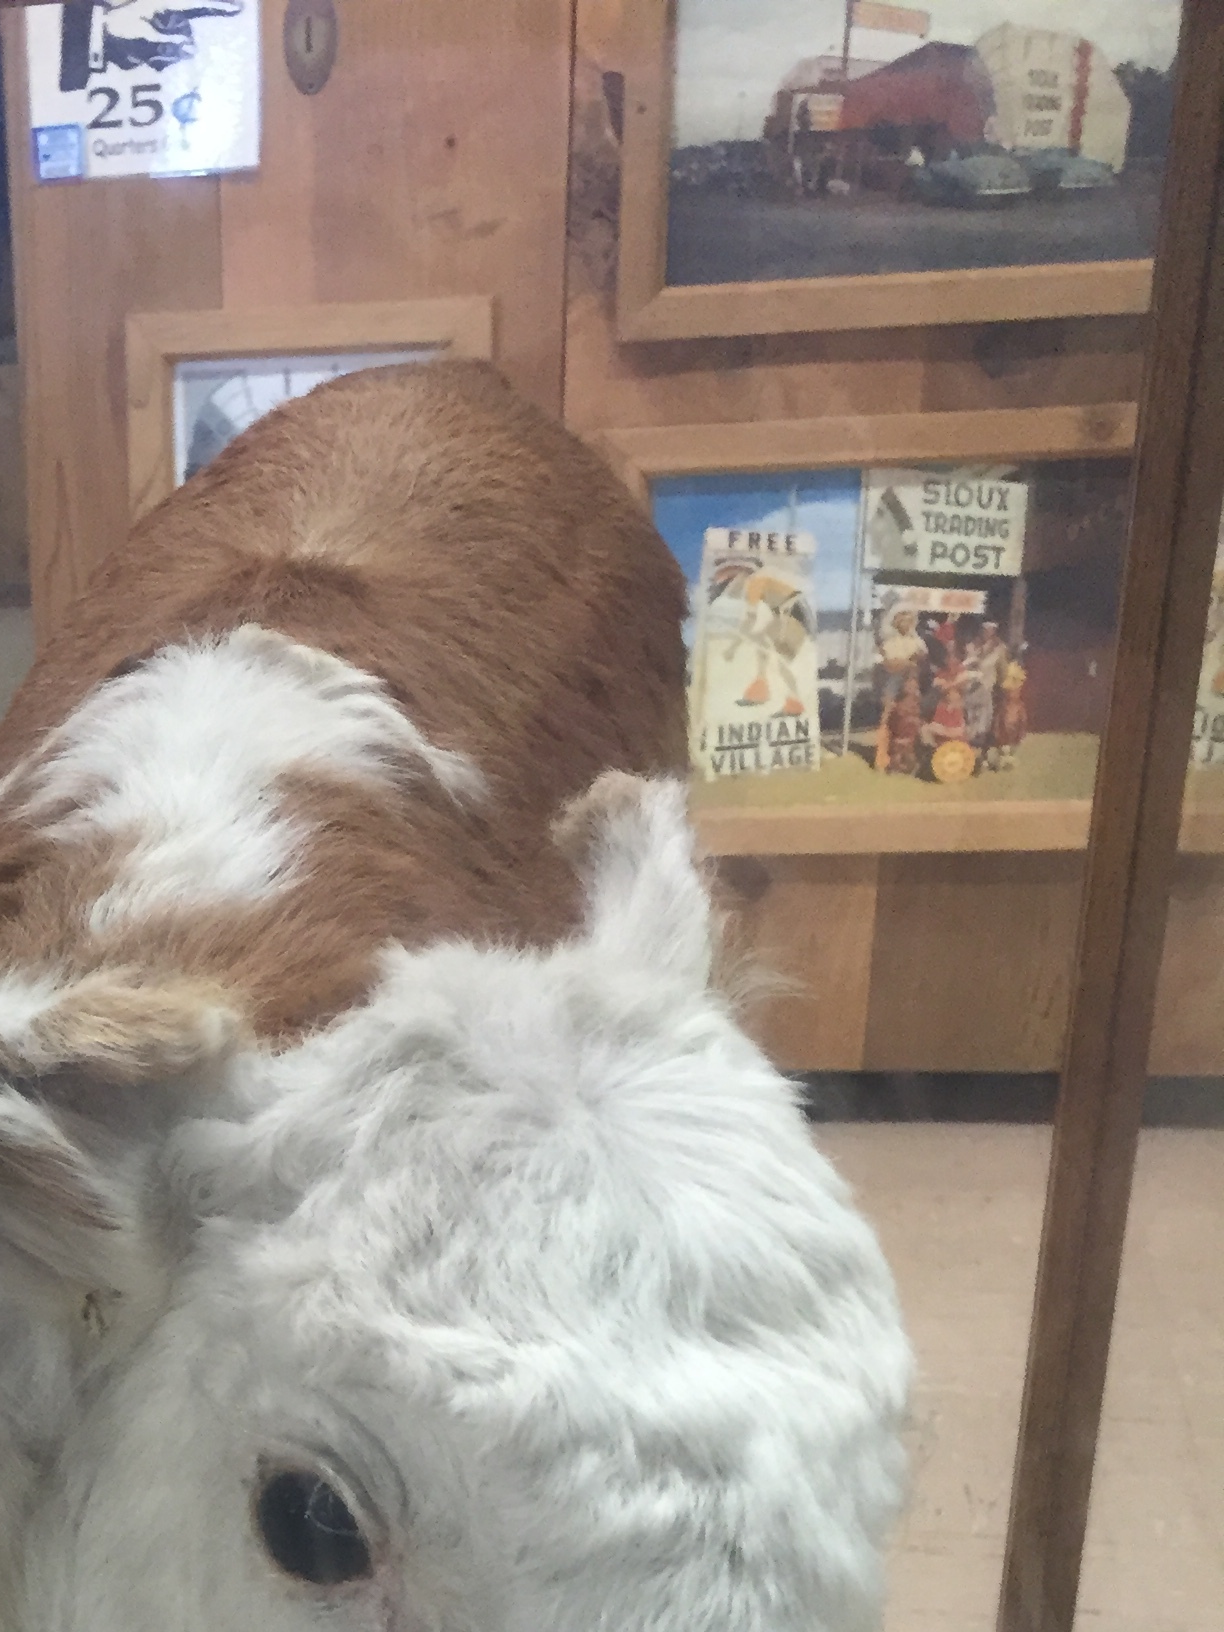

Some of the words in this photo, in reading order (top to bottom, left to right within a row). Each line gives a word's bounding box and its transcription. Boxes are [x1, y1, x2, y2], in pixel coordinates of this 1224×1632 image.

[922, 480, 1009, 511] SIOUX
[922, 511, 1010, 539] TRADING
[728, 530, 796, 555] FREE
[929, 541, 1006, 570] POST
[717, 719, 809, 745] INDIAN
[710, 743, 816, 772] VILLAGE
